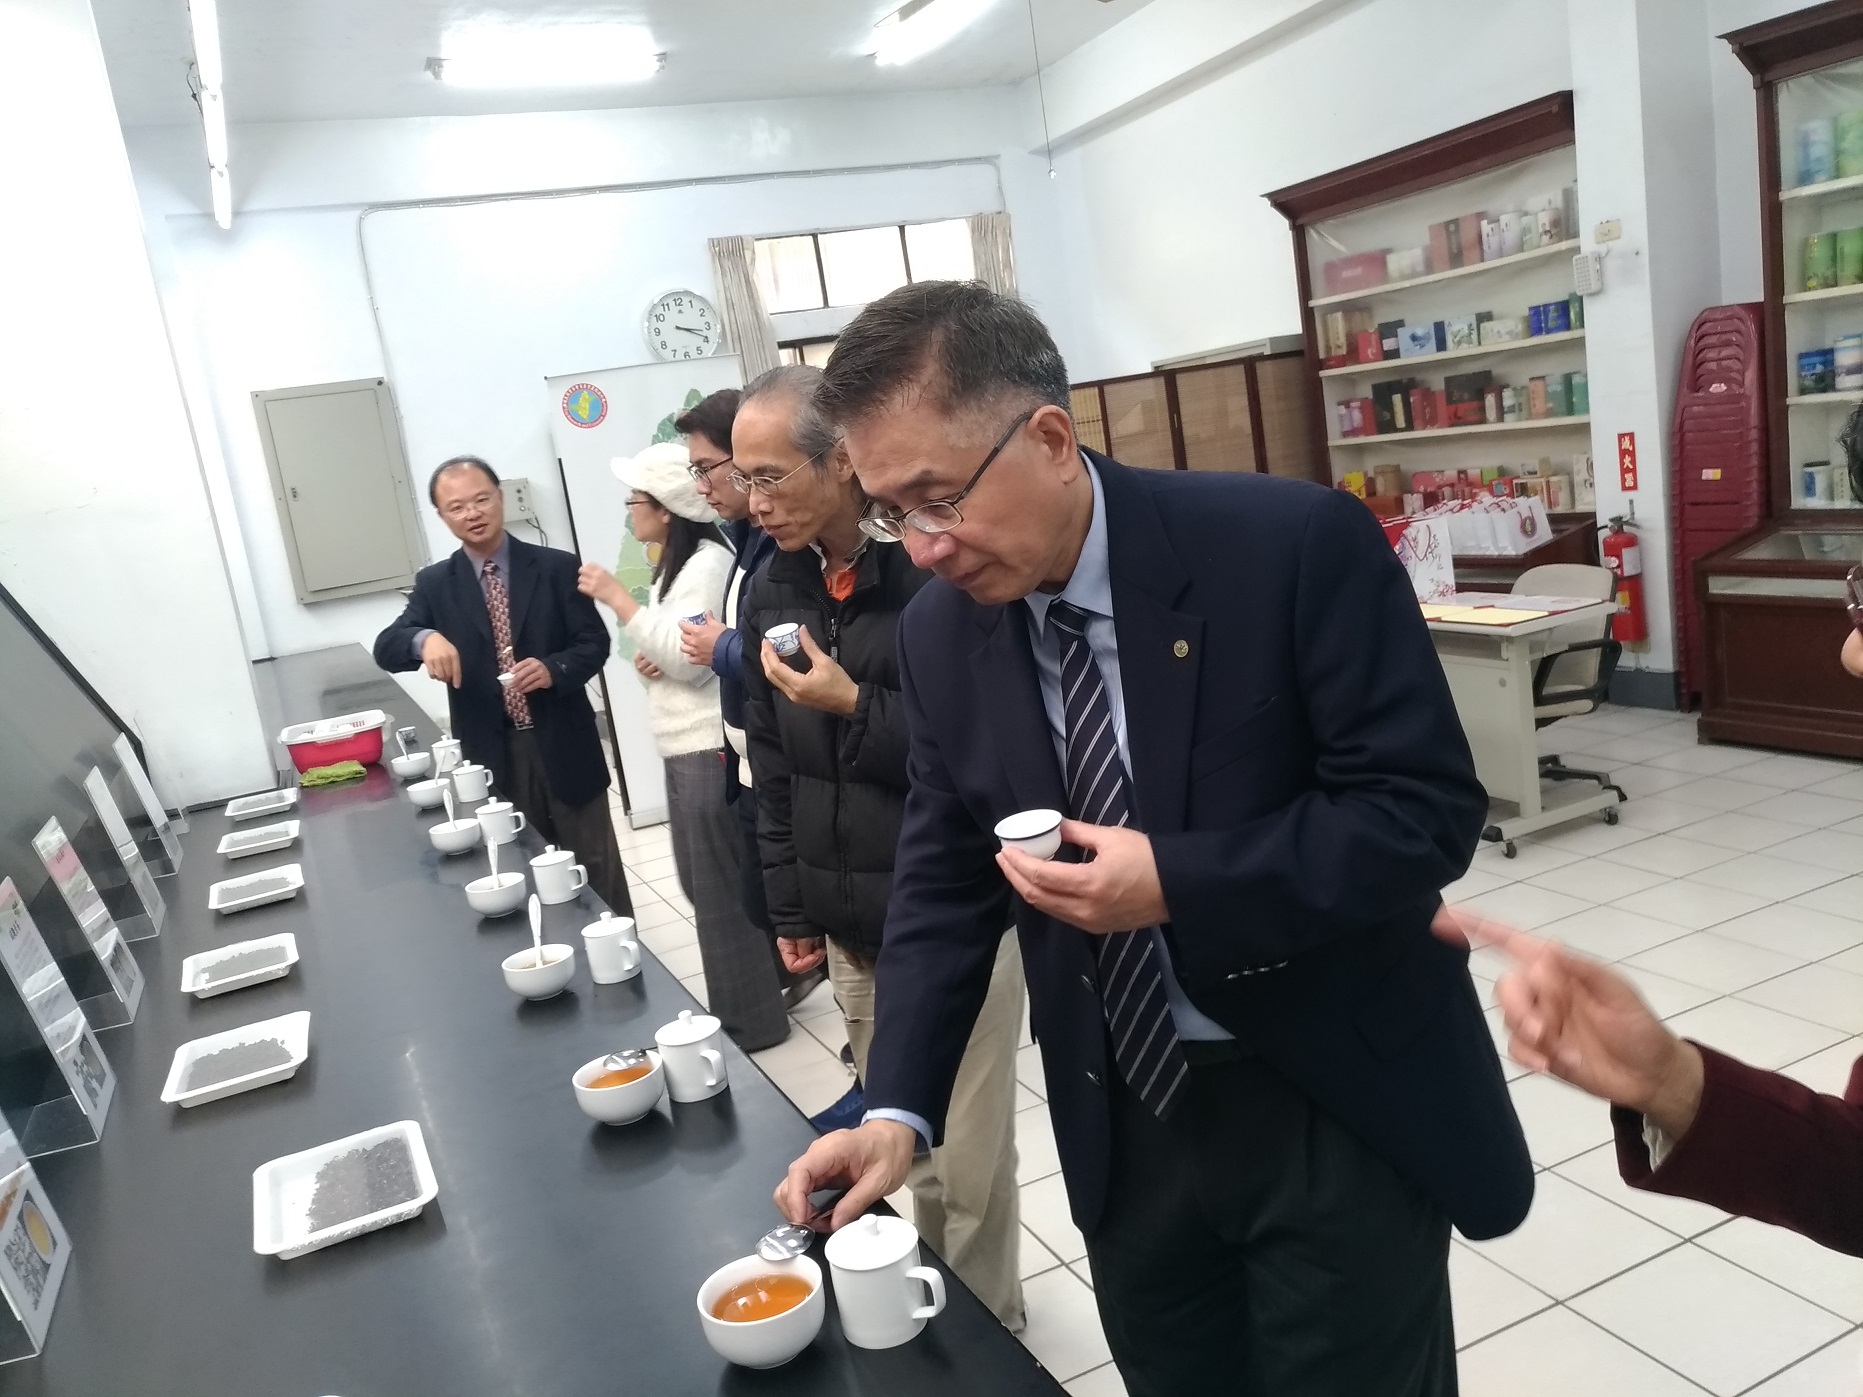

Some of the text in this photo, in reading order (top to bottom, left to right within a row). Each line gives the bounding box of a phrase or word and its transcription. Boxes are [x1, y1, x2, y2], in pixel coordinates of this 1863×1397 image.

[672, 298, 683, 306] 12
[688, 300, 693, 308] 1
[661, 302, 670, 312] 11
[699, 308, 705, 317] 2
[654, 313, 665, 322] 10
[705, 322, 711, 330] 3
[654, 327, 660, 336] 9
[703, 336, 709, 344] 4
[661, 341, 667, 350] 8
[671, 349, 677, 358] 7
[696, 346, 703, 355] 5
[1621, 435, 1634, 488] 滅火器
